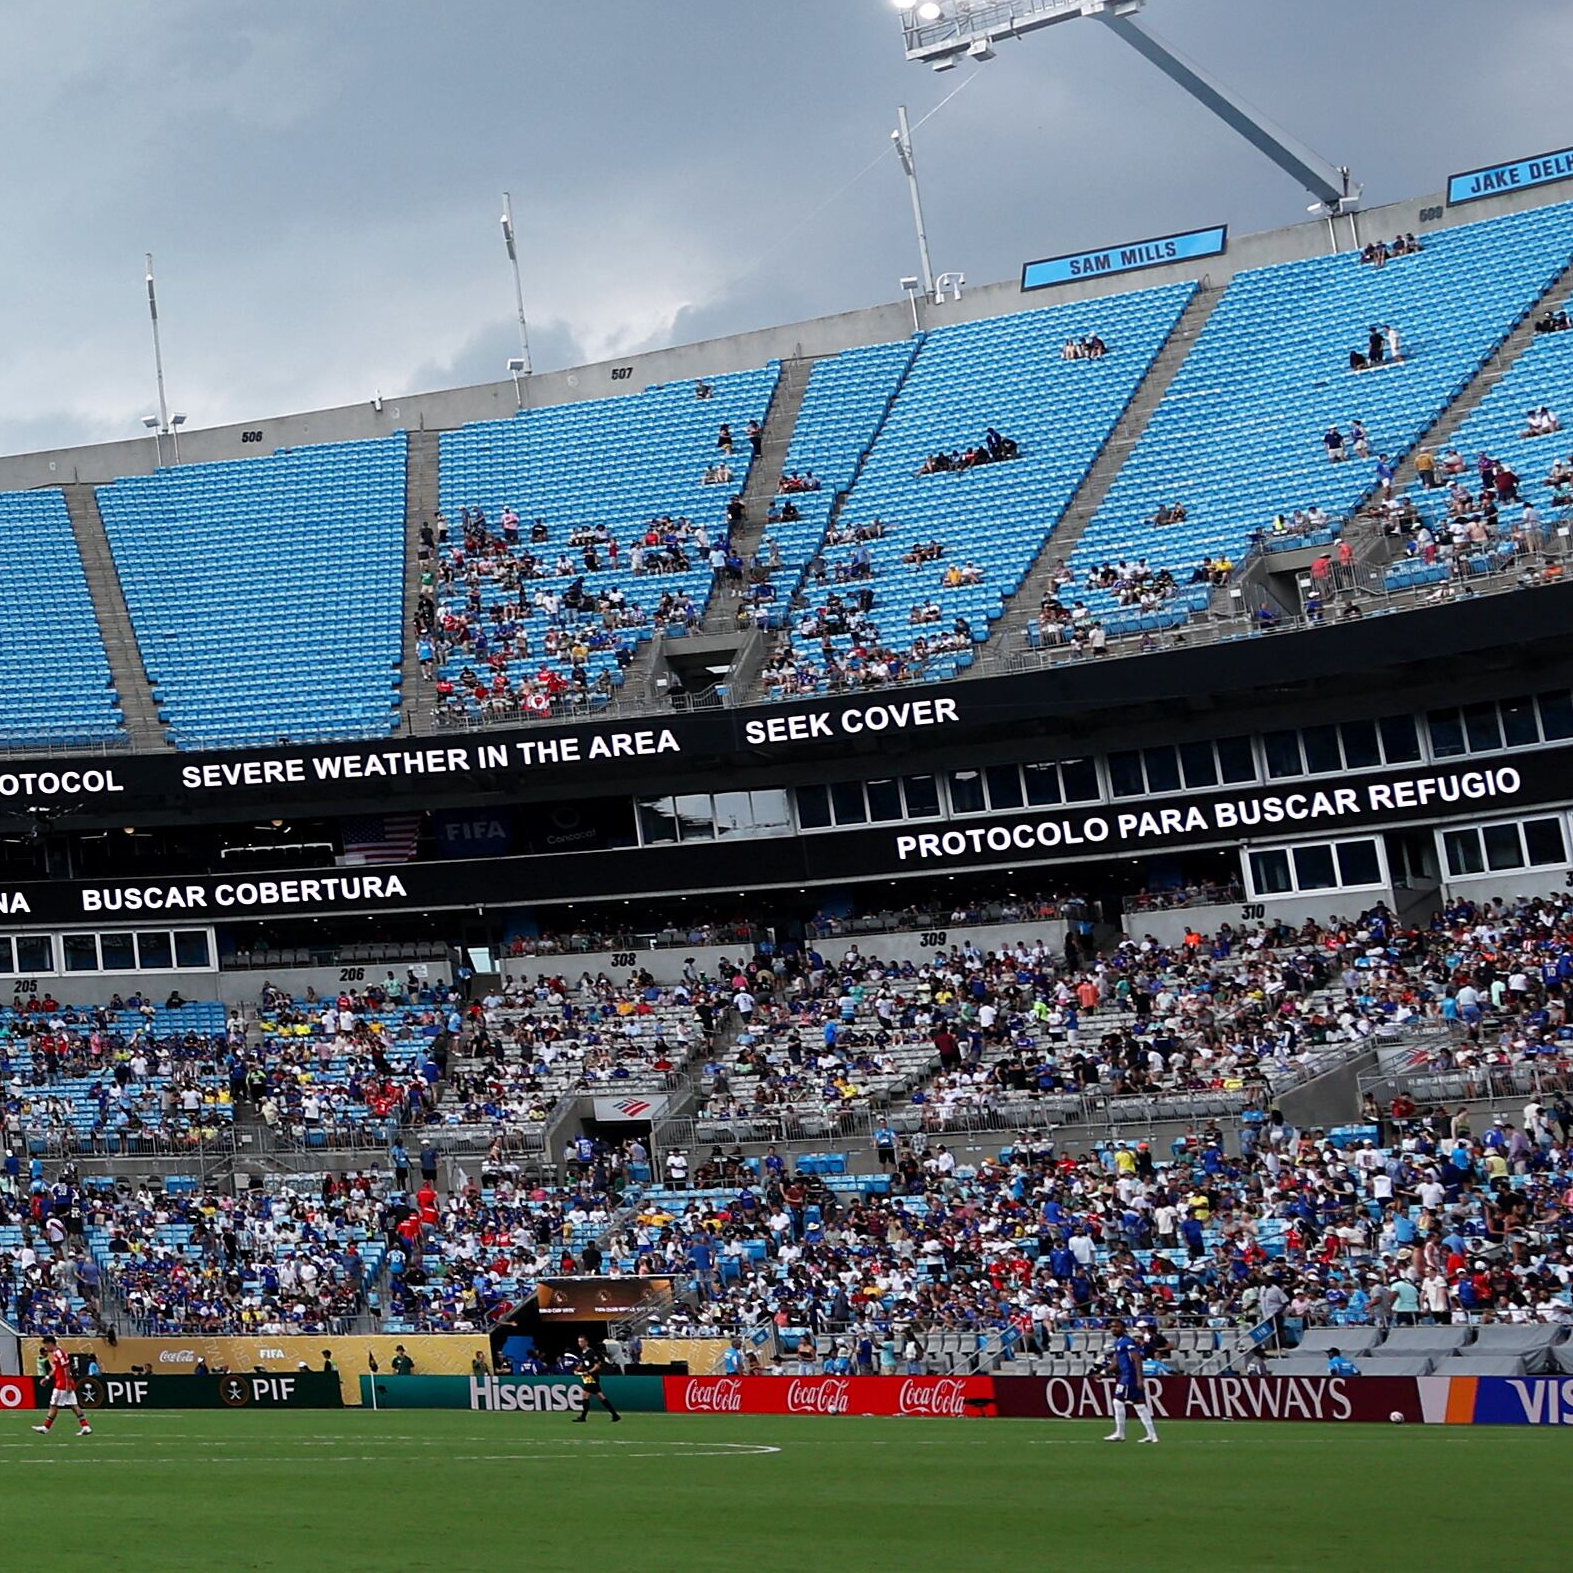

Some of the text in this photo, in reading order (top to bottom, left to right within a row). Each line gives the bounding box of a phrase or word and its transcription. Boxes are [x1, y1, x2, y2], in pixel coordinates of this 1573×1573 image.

[1471, 168, 1520, 194] JAKE
[1070, 241, 1176, 275] SAM MILLS
[611, 367, 634, 381] 507
[241, 430, 263, 443] 506
[745, 698, 960, 744] SEEK COVER
[182, 729, 681, 788] SEVERE WEATHER IN THE AREA
[896, 767, 1521, 860] PROTOCOLO PARA BUSCAR REFUGIO
[446, 821, 506, 841] FIFA
[82, 875, 407, 911] BUSCAR COBERTURA
[1241, 903, 1265, 921] 310
[919, 931, 947, 948] 309
[610, 952, 637, 968] 308
[339, 967, 365, 982] 206
[13, 979, 38, 994] 205
[259, 1348, 285, 1360] FIFA
[106, 1381, 148, 1404] PIF
[252, 1378, 295, 1401] PIF
[469, 1375, 583, 1411] Hisense
[1185, 1377, 1352, 1420] AIRWAYS
